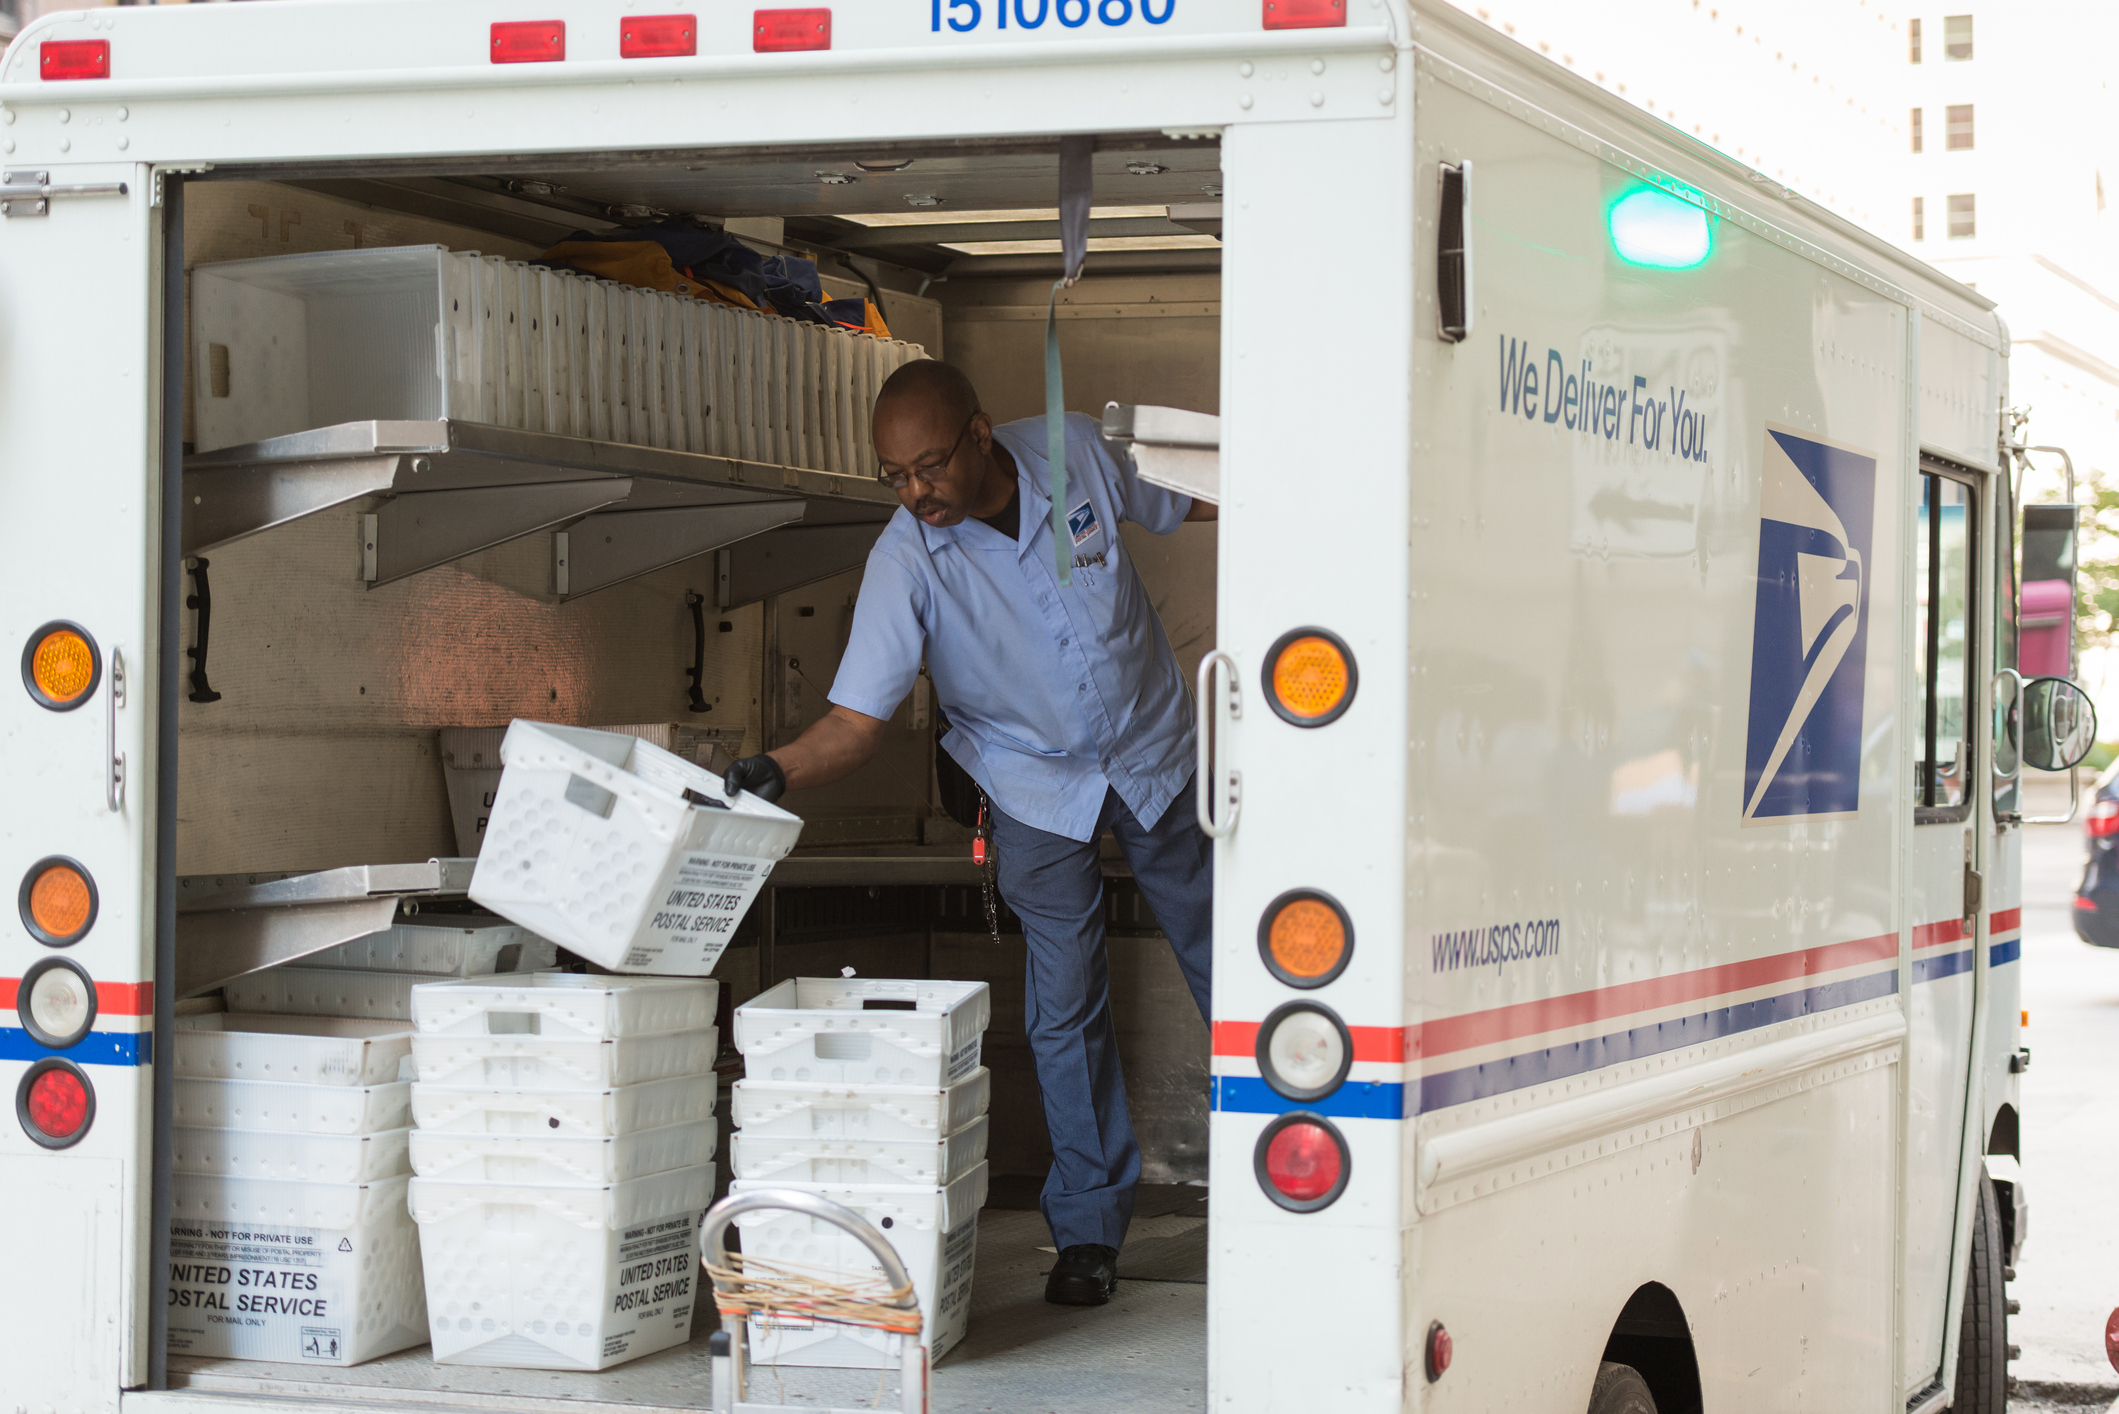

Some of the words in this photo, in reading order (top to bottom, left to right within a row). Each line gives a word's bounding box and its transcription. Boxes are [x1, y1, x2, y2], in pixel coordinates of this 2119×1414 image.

[932, 0, 1176, 32] 1510680
[1500, 334, 1538, 420] We
[1544, 348, 1626, 440] Deliver
[1630, 375, 1666, 450] For
[1670, 386, 1707, 463] You.
[722, 861, 731, 869] FOR
[666, 889, 705, 908] UNITED
[703, 893, 741, 910] STATES
[650, 912, 692, 930] POSTAL
[690, 916, 733, 932] SERVICE
[1432, 919, 1560, 976] www.usps.com
[170, 1227, 203, 1238] ARNING
[211, 1230, 229, 1239] NOT
[232, 1232, 251, 1241] FOR
[254, 1233, 291, 1244] PRIVATE
[294, 1236, 313, 1245] USE
[647, 1226, 655, 1235] NOT
[656, 1224, 664, 1233] FOR
[271, 1248, 291, 1256] POSTAL
[169, 1264, 231, 1284] NITED
[238, 1269, 318, 1291] STATES
[620, 1262, 653, 1286] UNITED
[655, 1253, 689, 1278] STATES
[168, 1288, 230, 1310] OSTAL
[237, 1294, 327, 1317] SERVICE
[614, 1288, 650, 1313] POSTAL
[652, 1277, 690, 1303] SERVICE
[208, 1315, 224, 1323] FOR
[226, 1317, 243, 1325] MAIL
[245, 1318, 266, 1326] ONLY
[638, 1312, 646, 1320] FOR
